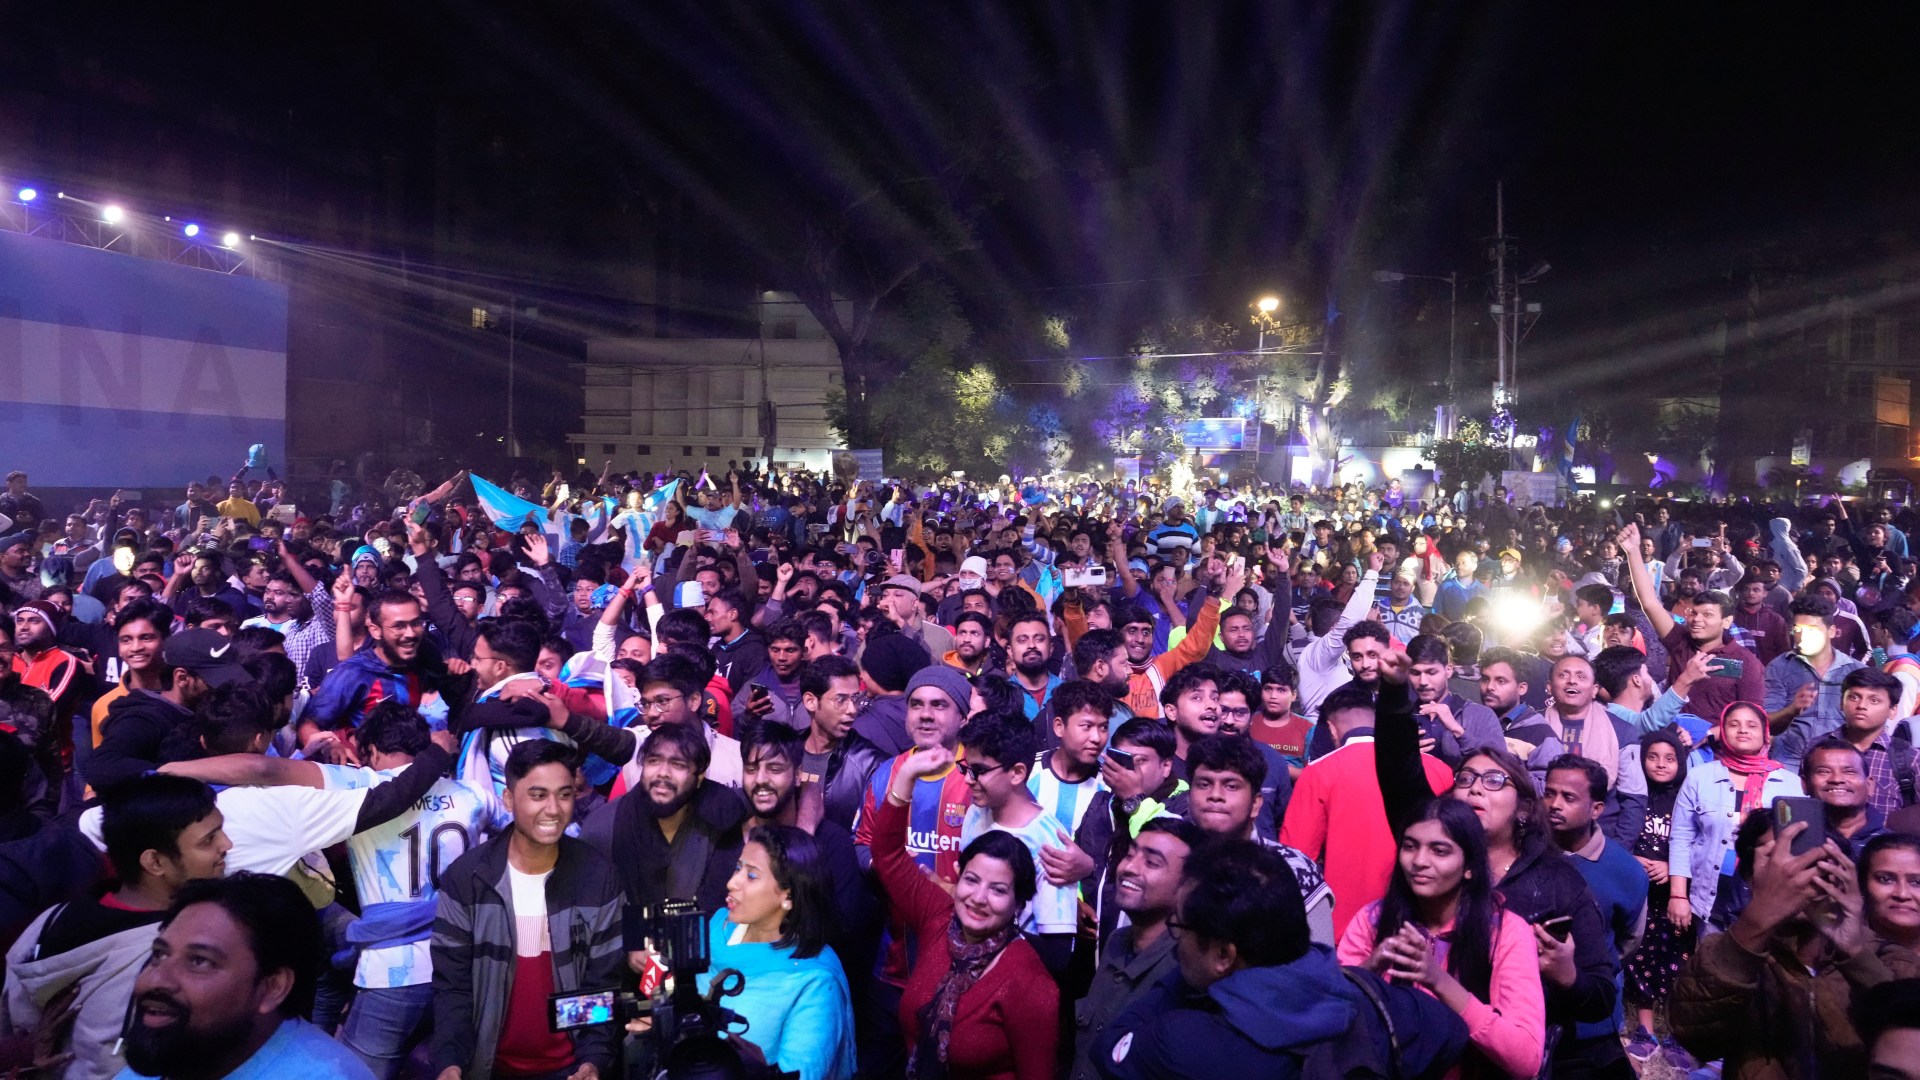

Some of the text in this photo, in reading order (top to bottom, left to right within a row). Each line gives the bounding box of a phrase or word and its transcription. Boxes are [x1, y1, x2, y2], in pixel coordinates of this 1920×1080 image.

[1283, 744, 1299, 752] GUN
[411, 795, 455, 812] MESSI
[399, 820, 470, 898] 10
